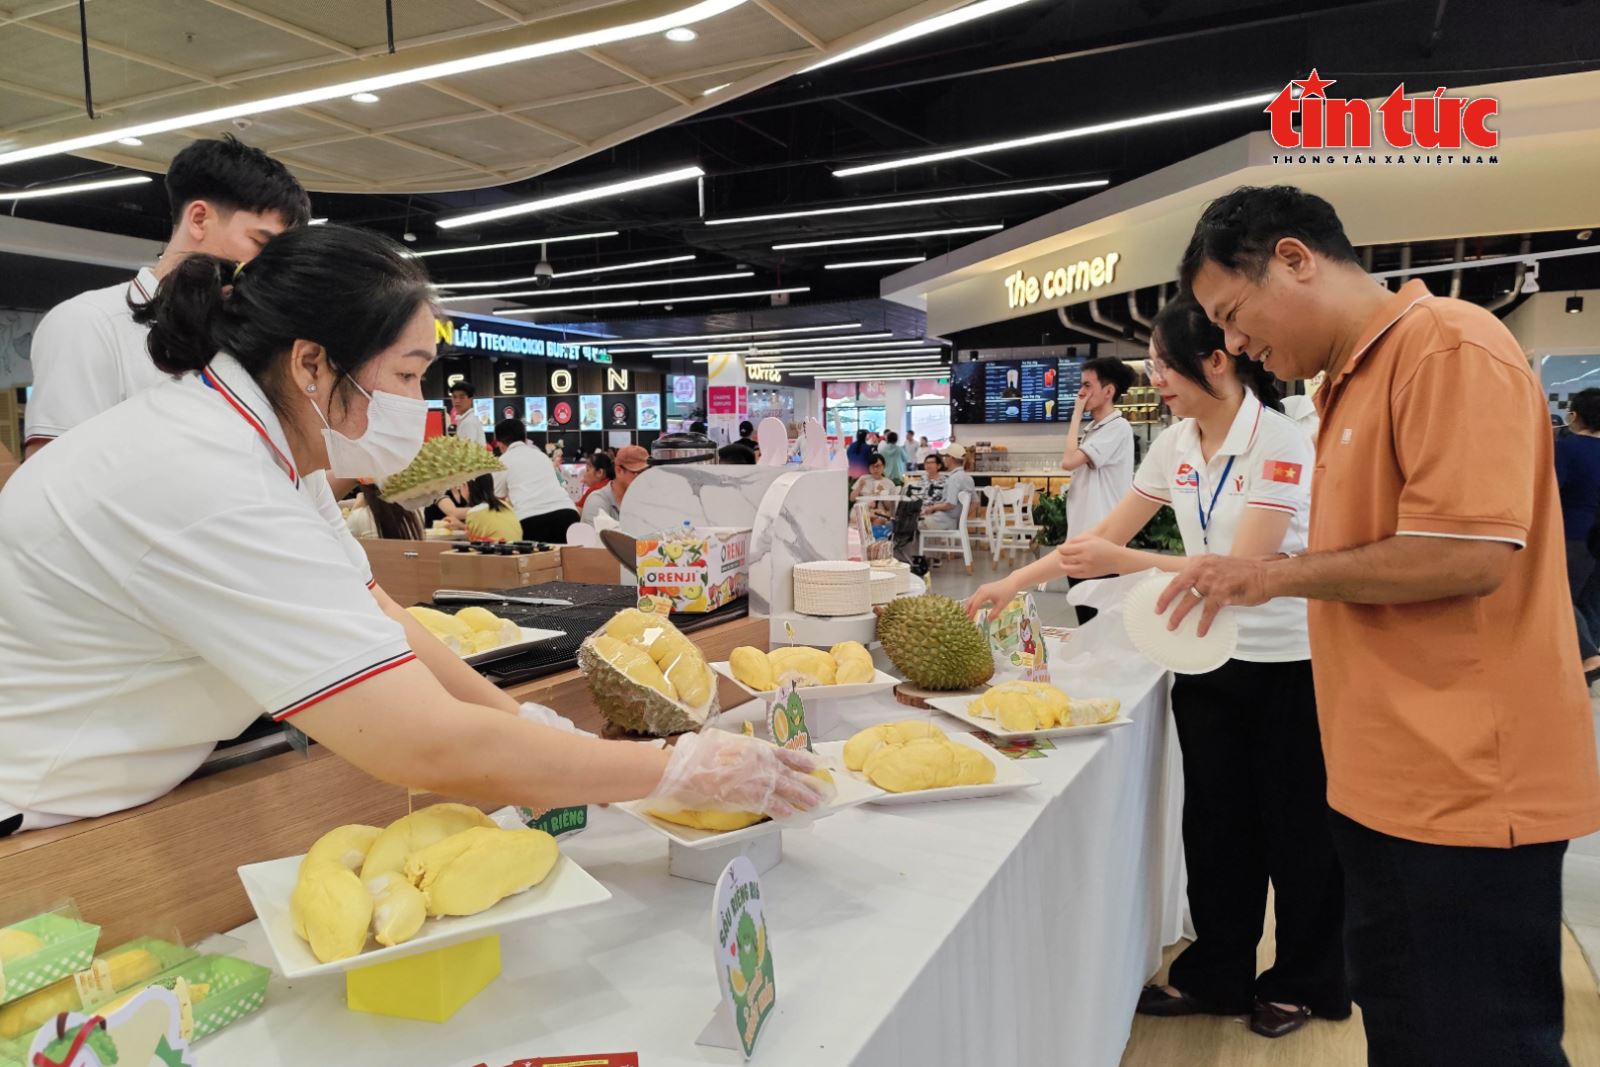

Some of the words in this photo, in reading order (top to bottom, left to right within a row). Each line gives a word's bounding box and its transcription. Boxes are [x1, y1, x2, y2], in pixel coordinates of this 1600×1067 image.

[1004, 270, 1041, 308] The
[1043, 252, 1120, 300] corner
[647, 572, 696, 583] ORENJI
[550, 808, 584, 832] RIÊNG
